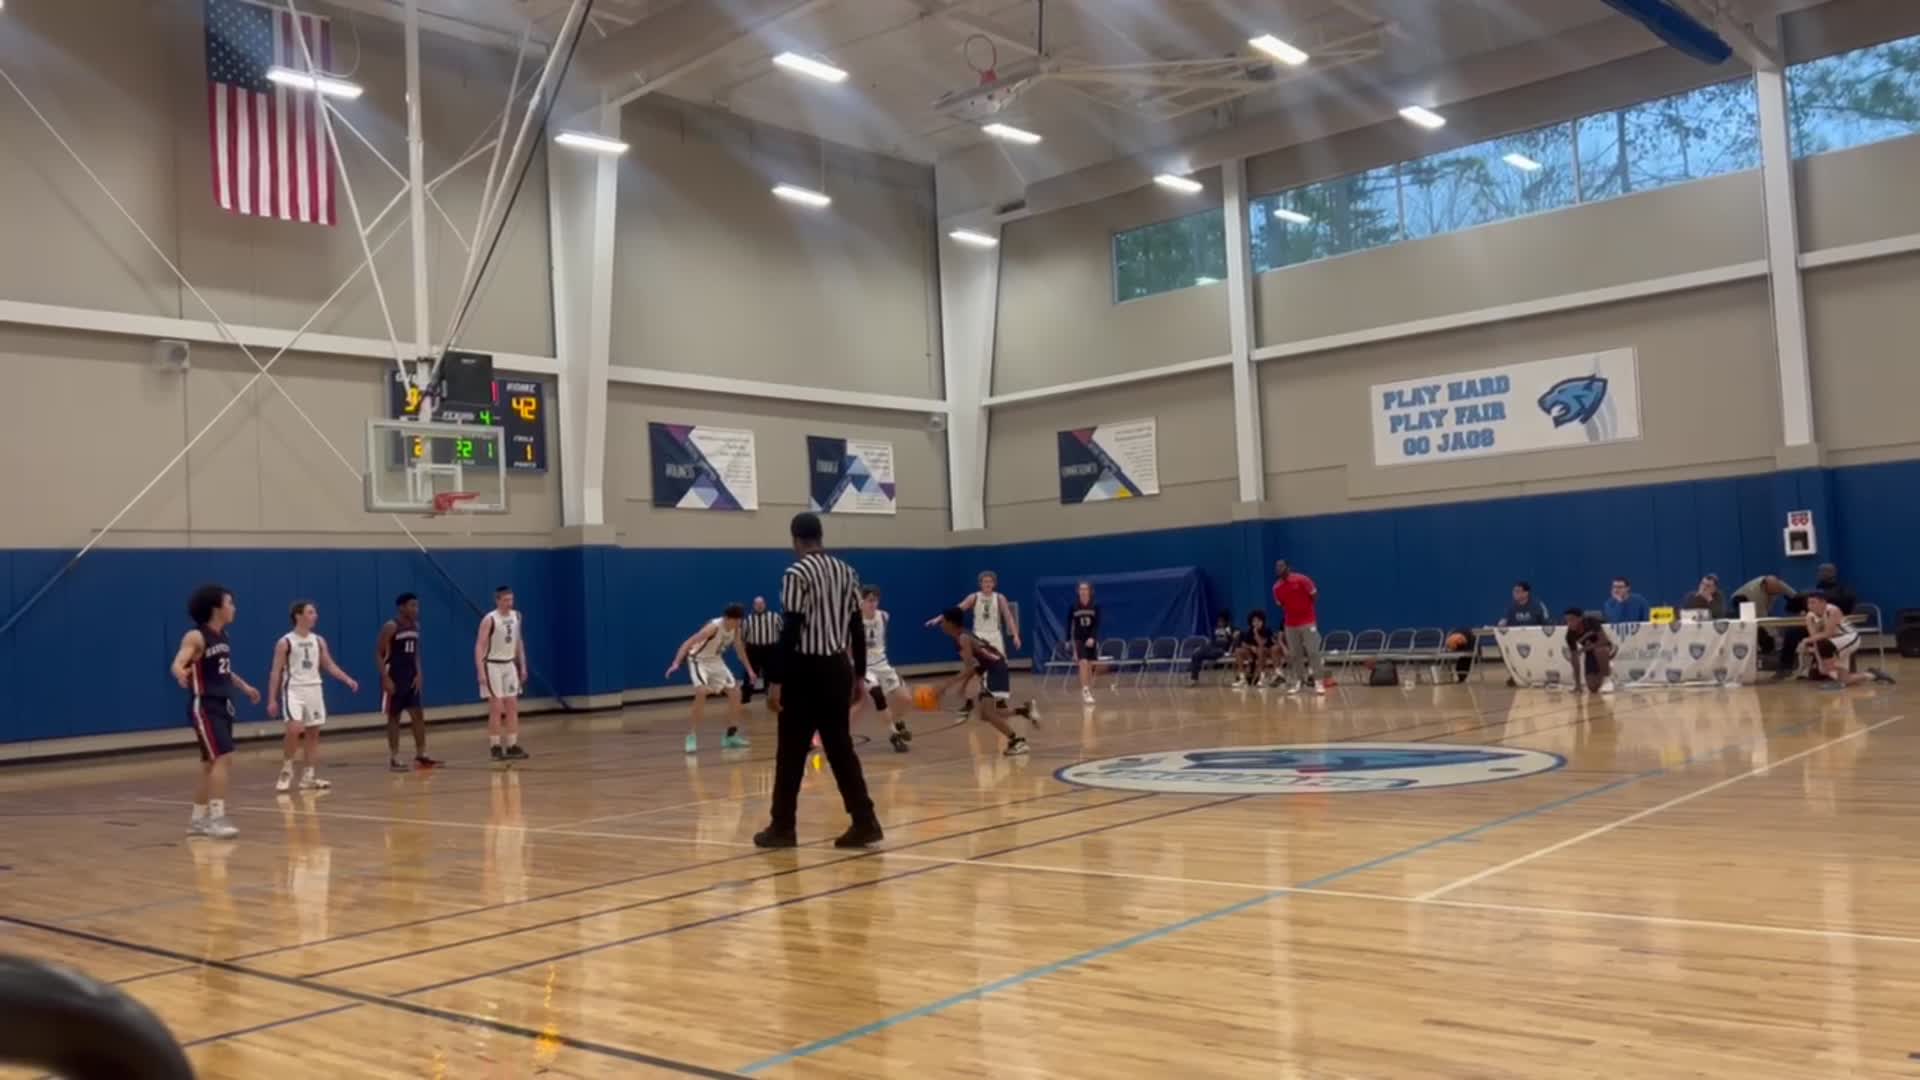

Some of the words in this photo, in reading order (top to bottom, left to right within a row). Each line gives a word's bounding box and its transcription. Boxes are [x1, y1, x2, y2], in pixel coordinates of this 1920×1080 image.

[1383, 384, 1442, 410] PLAY
[1447, 375, 1511, 401] HARD
[511, 396, 537, 420] 42
[1389, 408, 1449, 434] PLAY
[1454, 401, 1507, 426] FAIR
[1402, 435, 1431, 456] GO
[1437, 428, 1496, 453] JAGS
